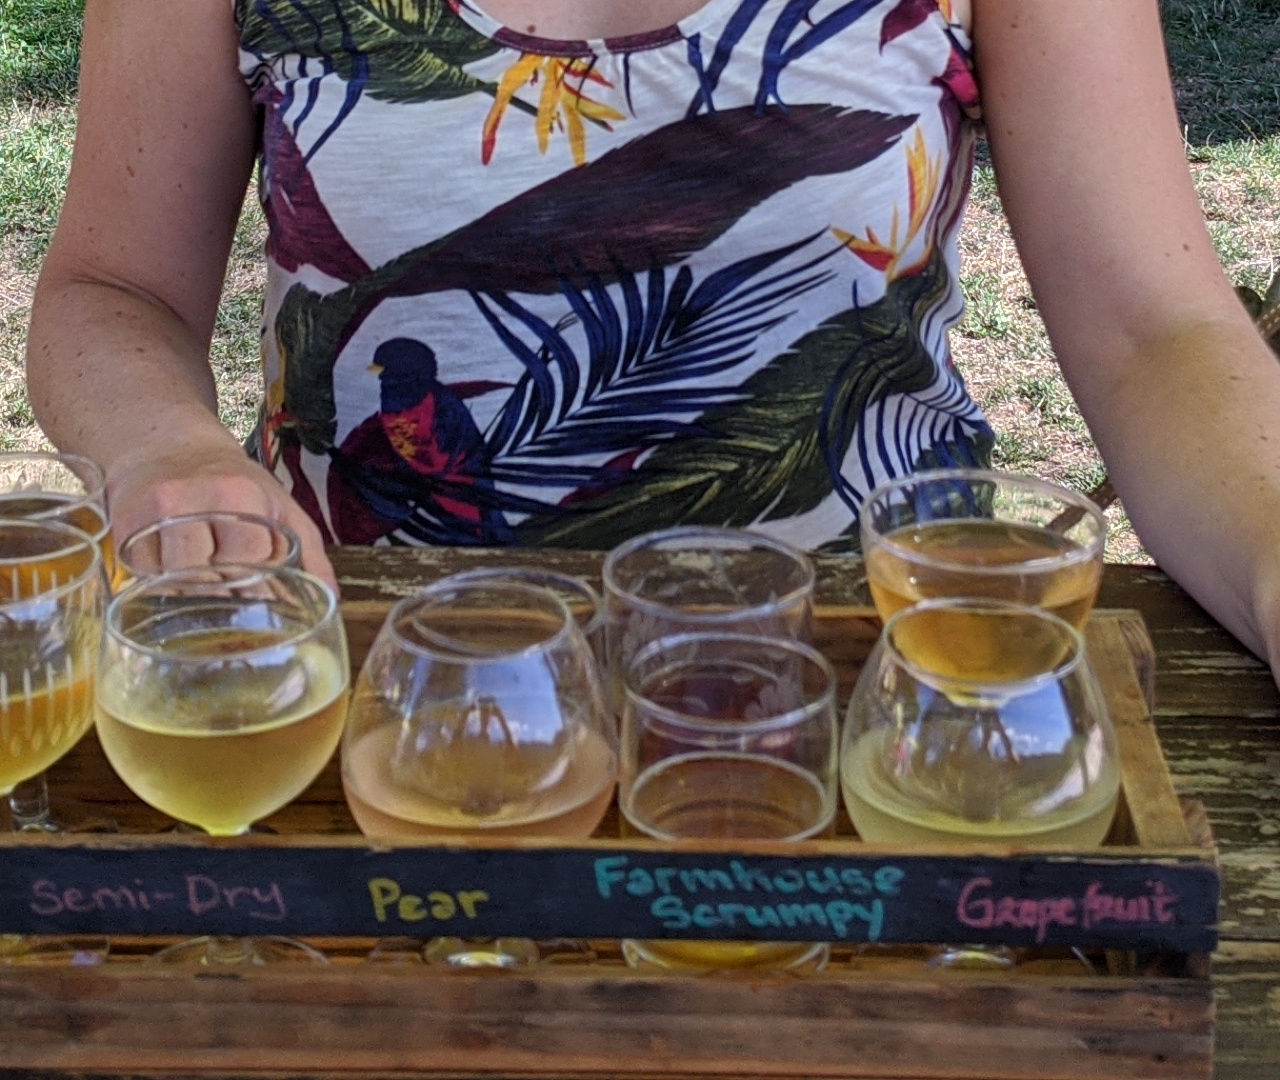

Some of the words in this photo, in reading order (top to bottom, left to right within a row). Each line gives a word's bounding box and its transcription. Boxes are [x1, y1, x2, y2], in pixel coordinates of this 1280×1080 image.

[29, 873, 287, 922] Semi-Dry
[368, 876, 491, 924] Pear
[593, 855, 905, 899] Farmhouse
[650, 895, 886, 939] Scrumpy
